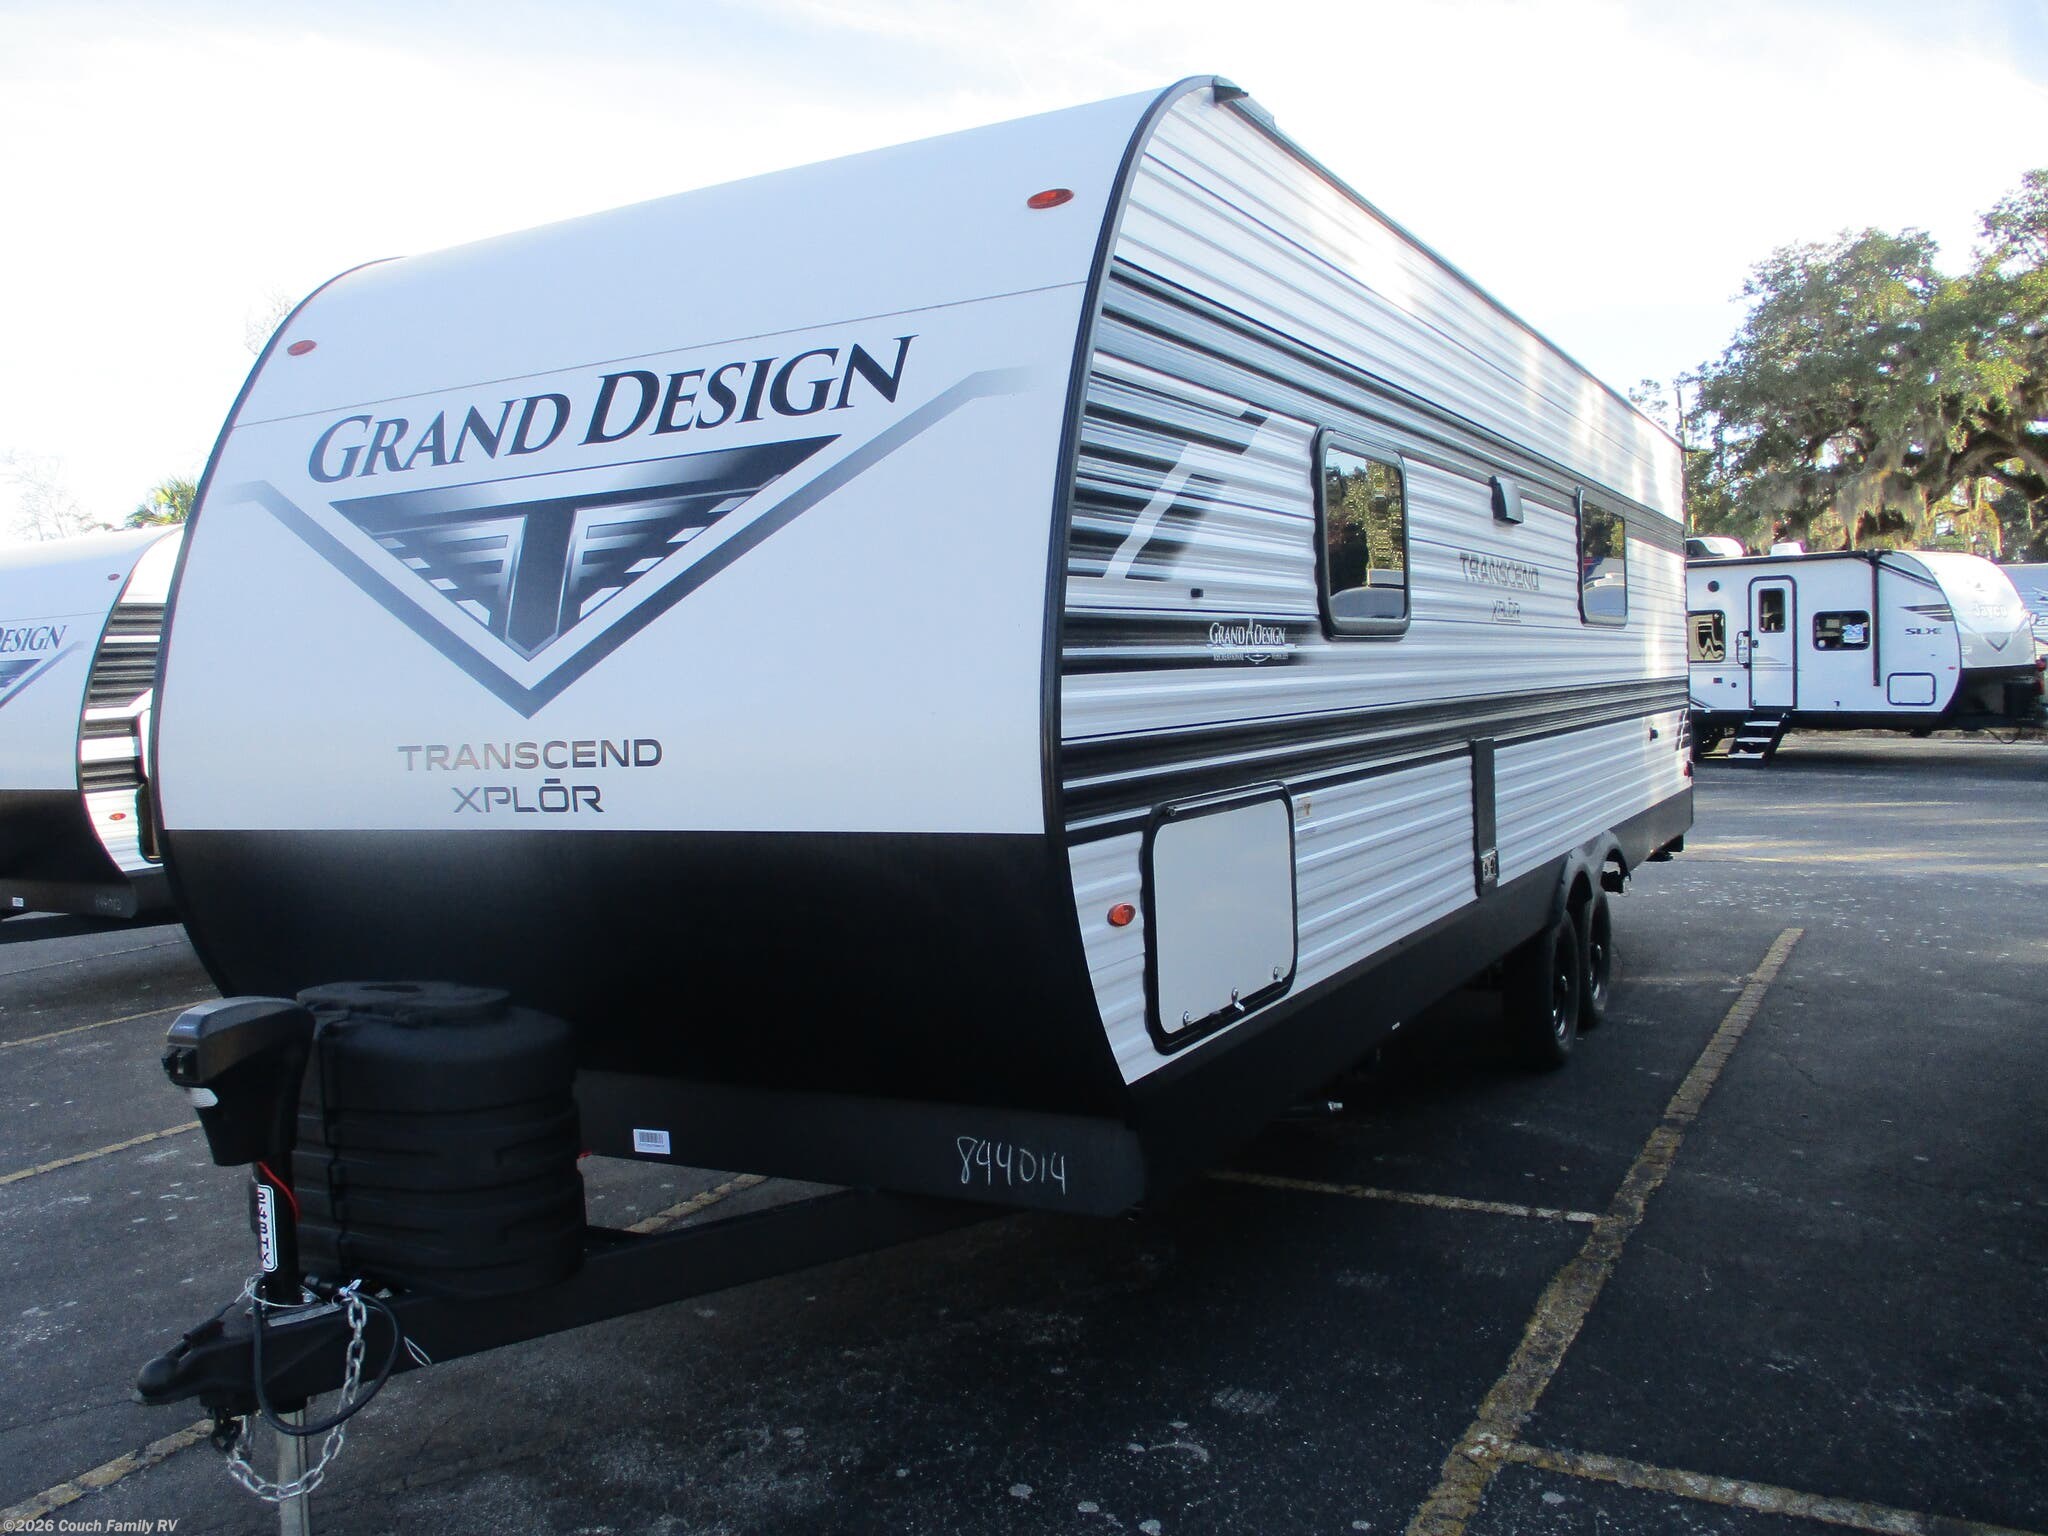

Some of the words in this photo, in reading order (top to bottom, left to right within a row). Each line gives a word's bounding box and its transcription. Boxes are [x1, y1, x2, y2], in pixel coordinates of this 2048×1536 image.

[307, 392, 571, 484] GRAND
[578, 335, 919, 446] DESIGN
[1459, 552, 1540, 590] TRANSCEND
[0, 625, 68, 653] ESIGN
[1209, 622, 1245, 645] GRAND
[1255, 624, 1286, 645] DESIGN
[397, 739, 663, 772] TRANSCEND
[956, 1136, 1066, 1196] 844014
